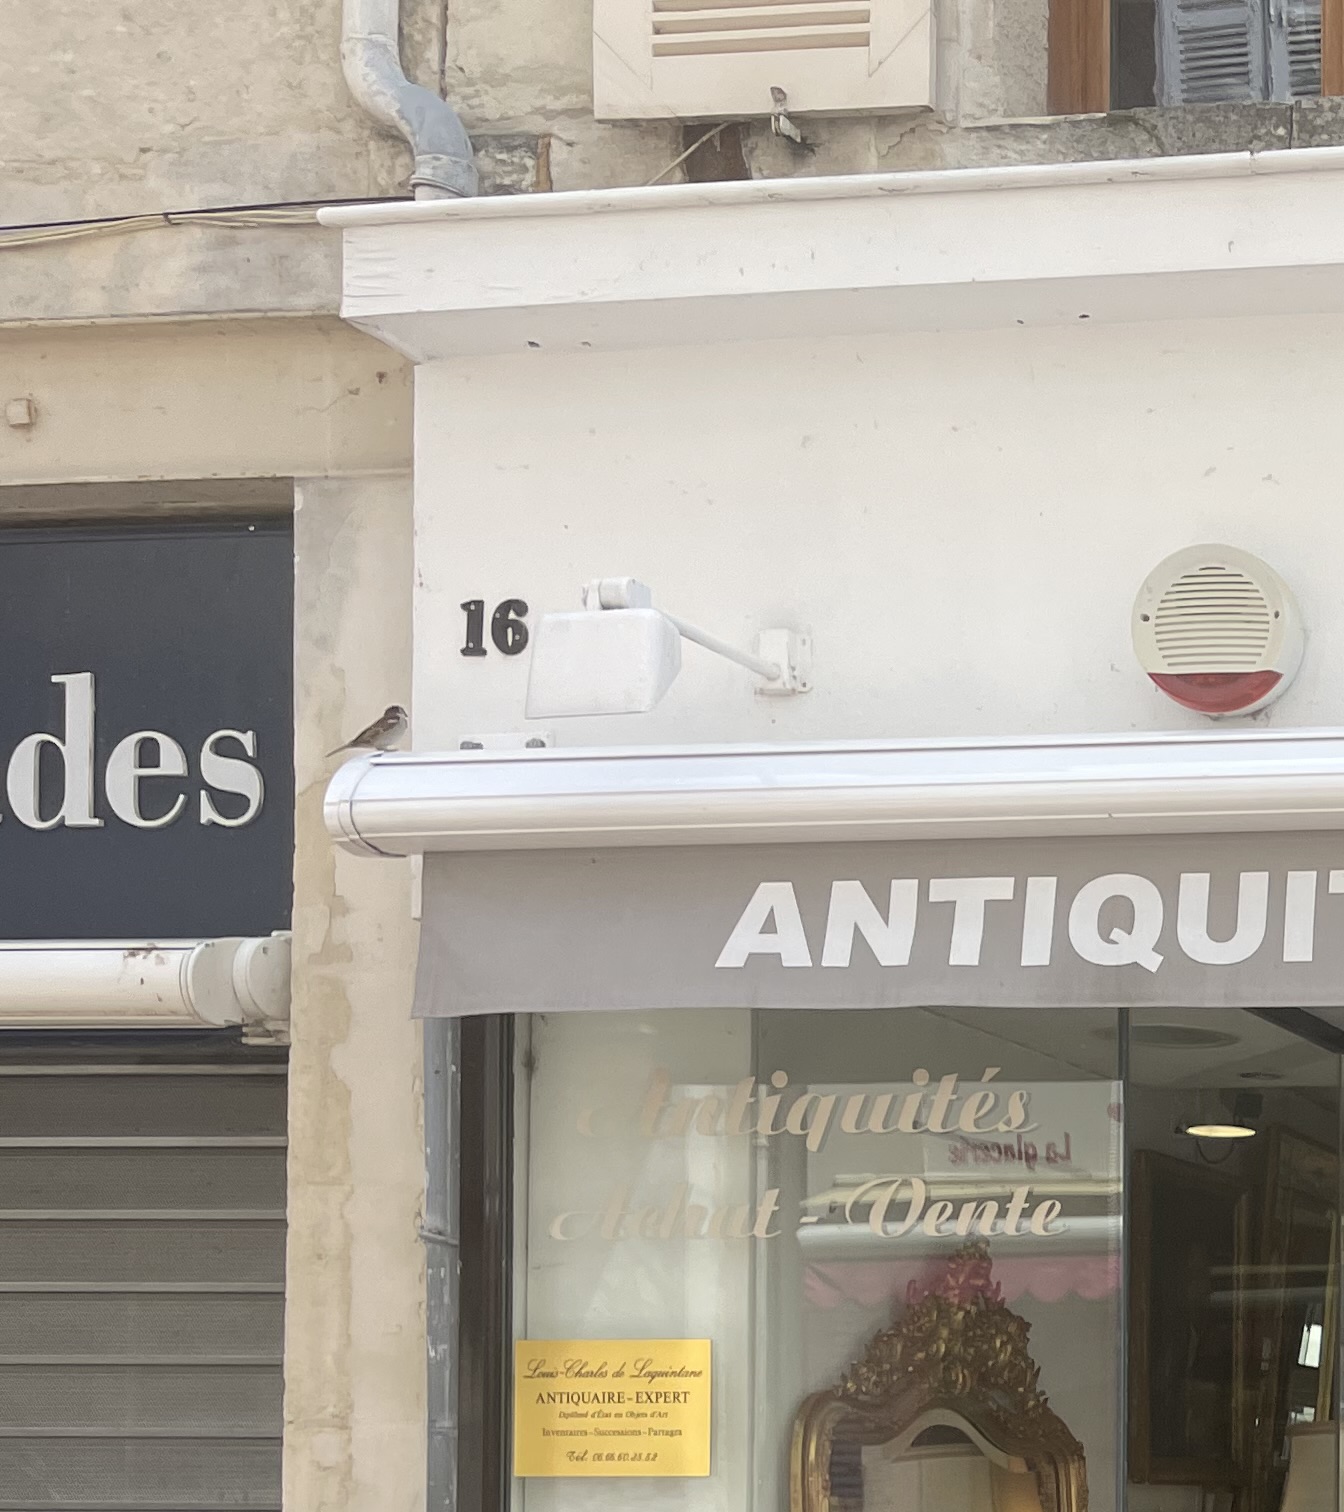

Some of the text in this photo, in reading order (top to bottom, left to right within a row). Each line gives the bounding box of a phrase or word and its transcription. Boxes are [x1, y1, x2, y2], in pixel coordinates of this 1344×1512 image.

[460, 598, 529, 656] 16
[0, 671, 265, 829] des
[576, 1067, 1041, 1152] Antiquités
[550, 1182, 783, 1241] Achat
[840, 1175, 1071, 1241] Vente
[611, 1361, 627, 1379] de
